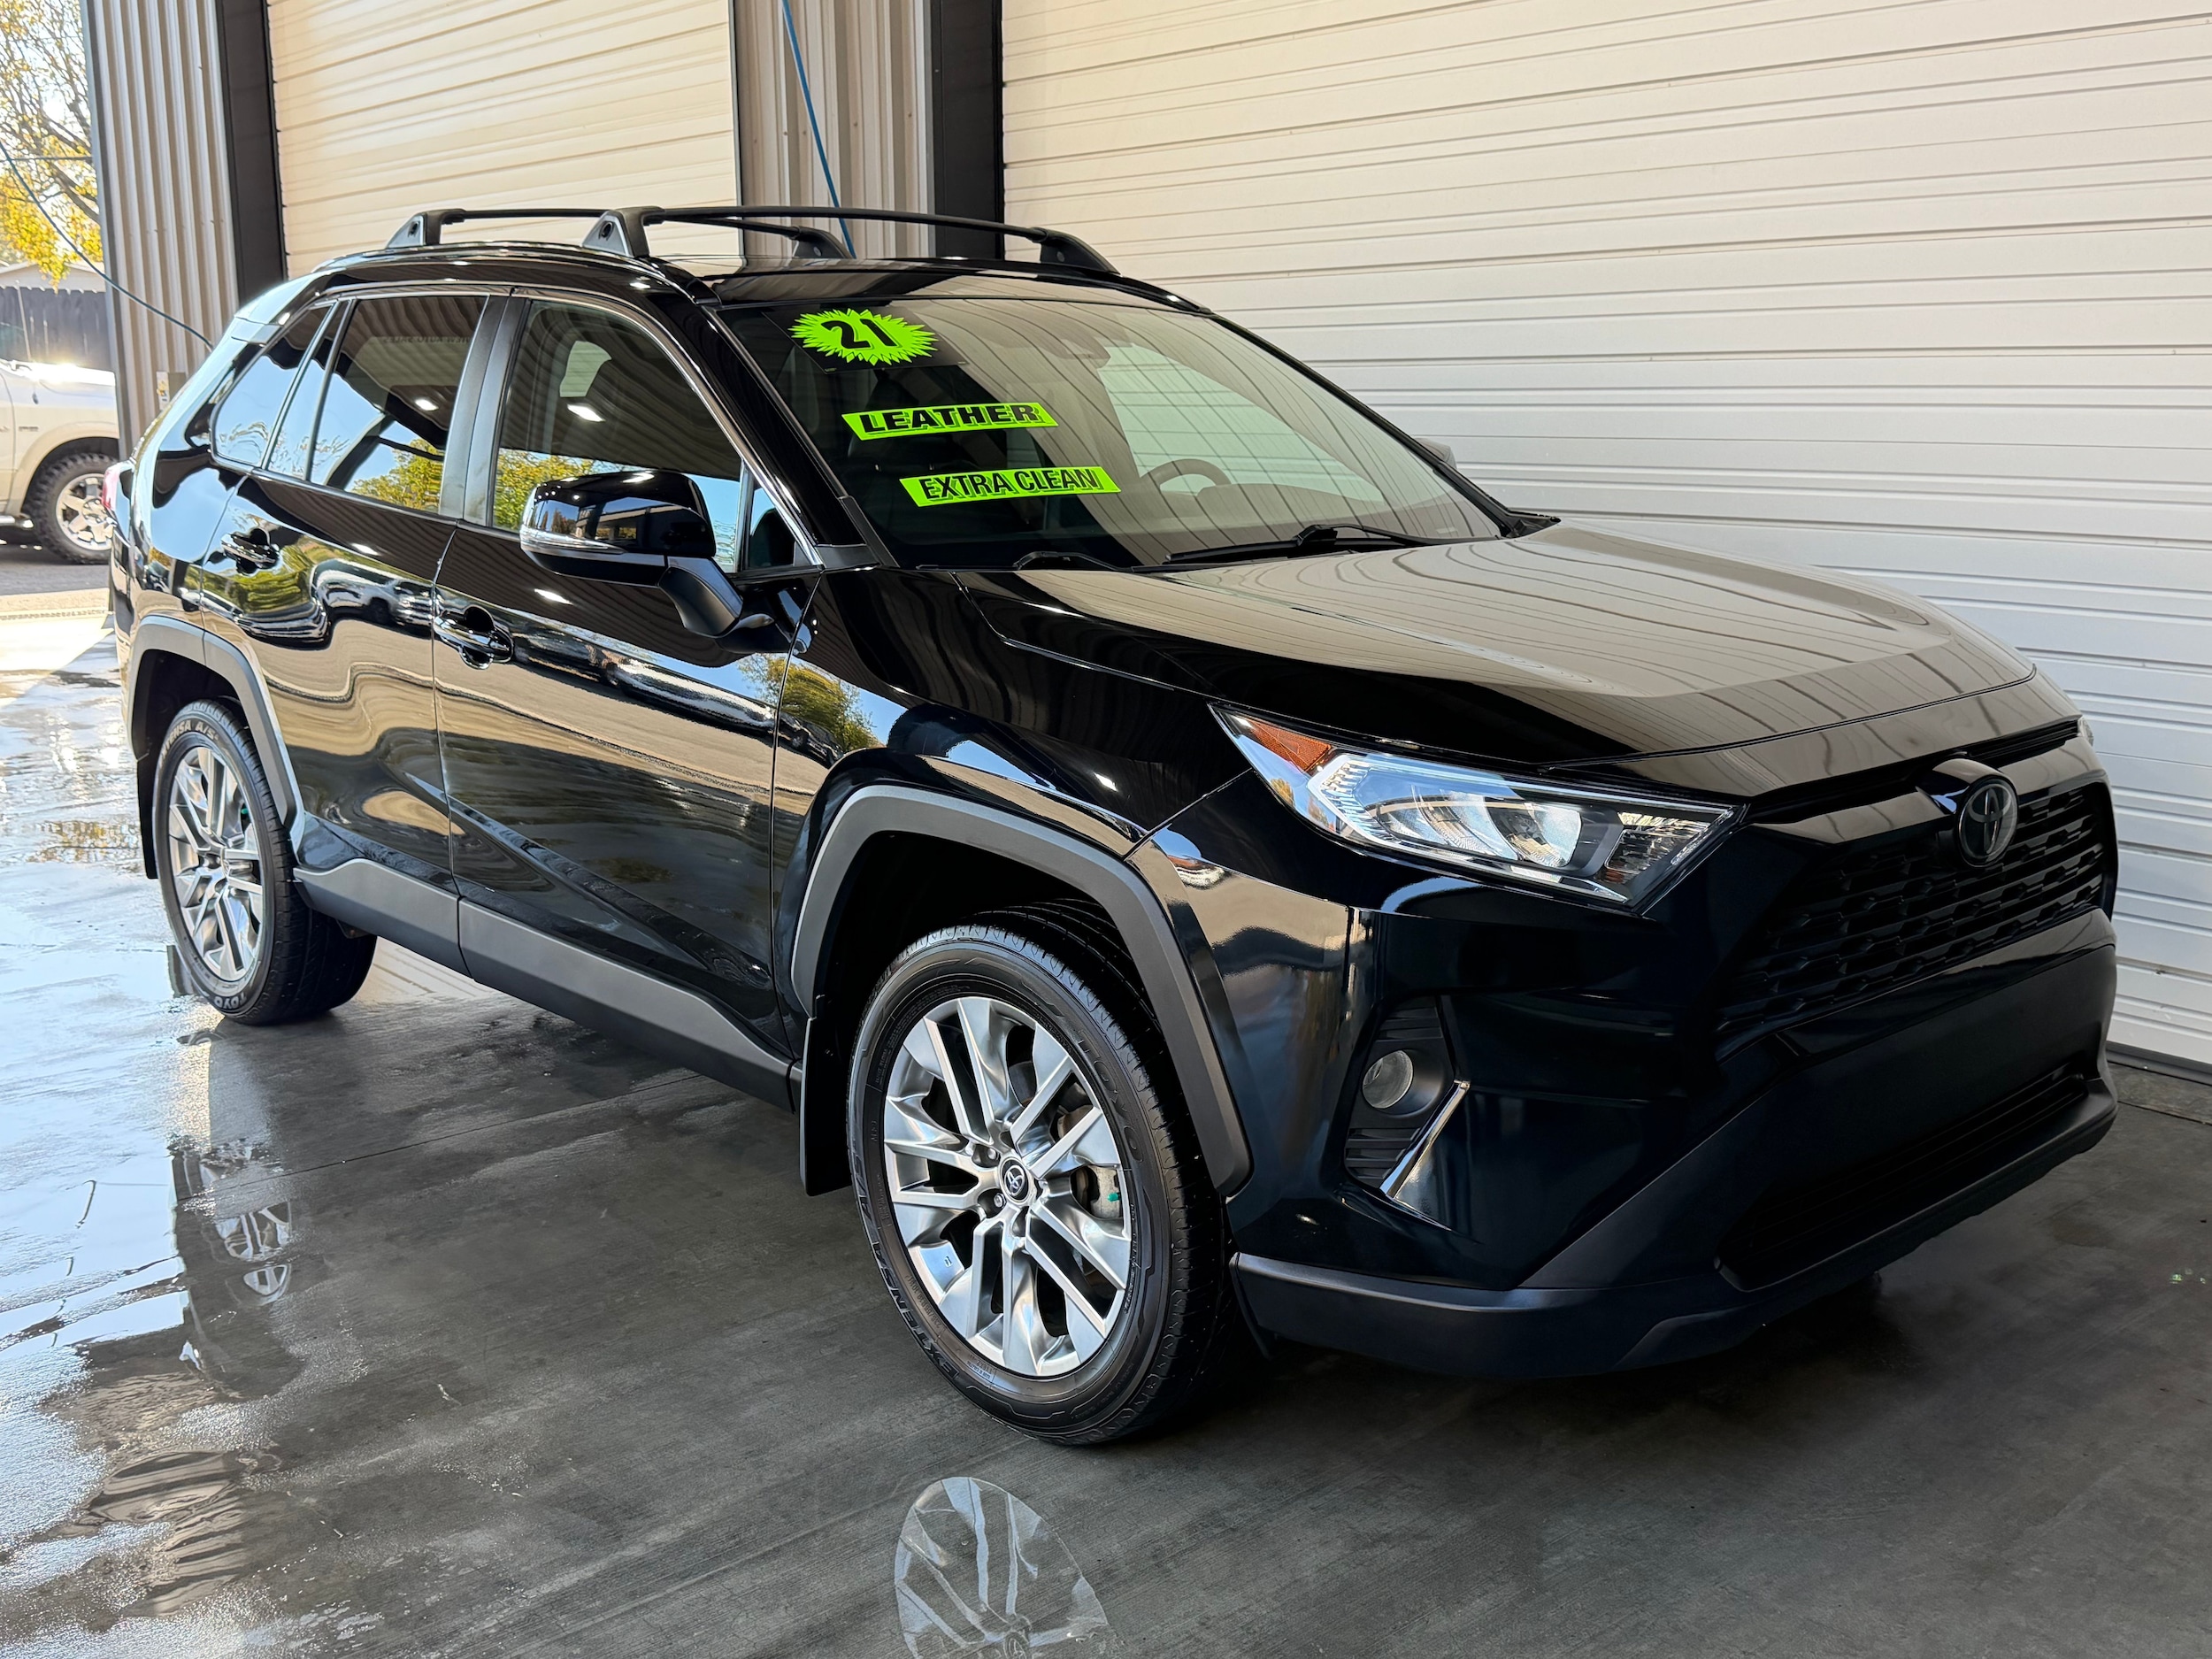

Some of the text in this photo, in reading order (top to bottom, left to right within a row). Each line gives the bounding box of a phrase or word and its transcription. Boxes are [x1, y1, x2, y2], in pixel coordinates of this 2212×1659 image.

[821, 318, 897, 349] 21
[859, 404, 1044, 434] LEATHER
[919, 468, 1102, 501] EXTRA CLEAN
[214, 992, 247, 1010] TOYO
[1077, 1029, 1144, 1163] TOYO
[872, 1240, 960, 1380] EXTENSA
